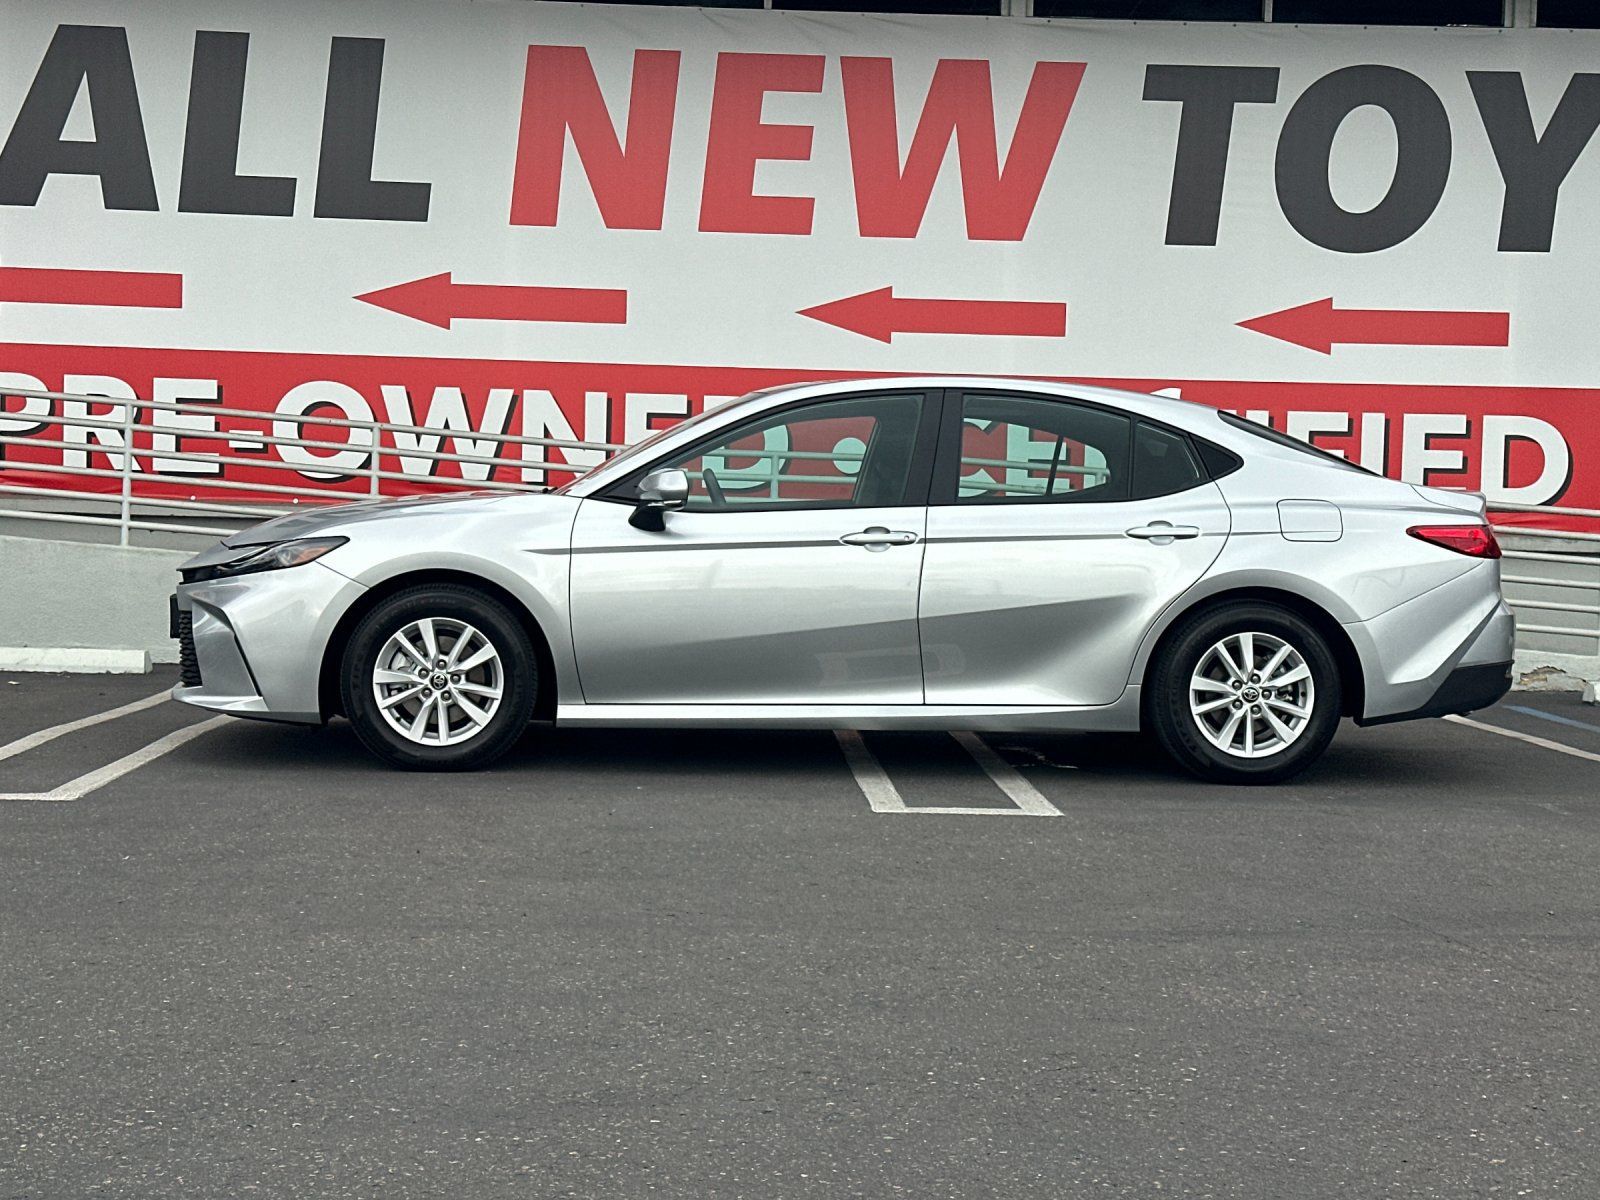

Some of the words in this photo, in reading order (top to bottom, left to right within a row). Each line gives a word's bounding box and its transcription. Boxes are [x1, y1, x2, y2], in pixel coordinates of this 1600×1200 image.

[0, 25, 431, 222] ALL
[509, 44, 1089, 242] NEW
[1142, 64, 1600, 254] TOY
